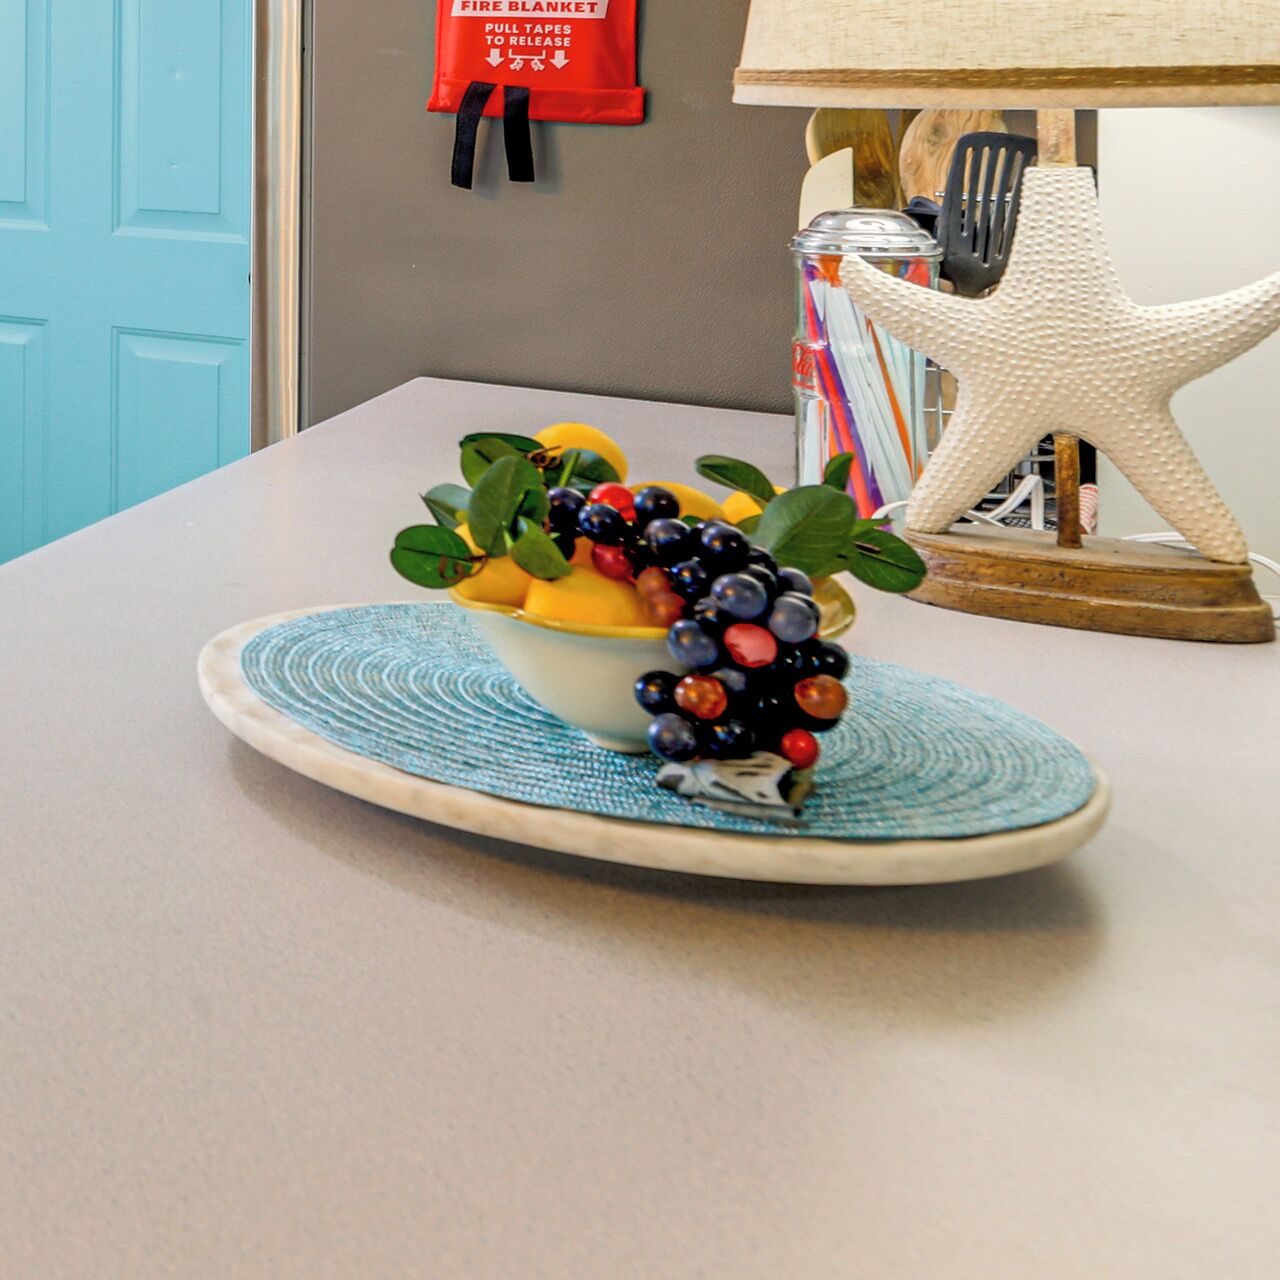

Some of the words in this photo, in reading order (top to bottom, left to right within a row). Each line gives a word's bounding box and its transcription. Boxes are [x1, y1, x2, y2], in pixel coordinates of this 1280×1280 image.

[460, 0, 503, 12] FIRE
[507, 1, 599, 14] BLANKET
[484, 23, 519, 33] PULL
[523, 23, 572, 35] TAPES
[484, 35, 505, 46] TO
[508, 36, 572, 47] RELEASE
